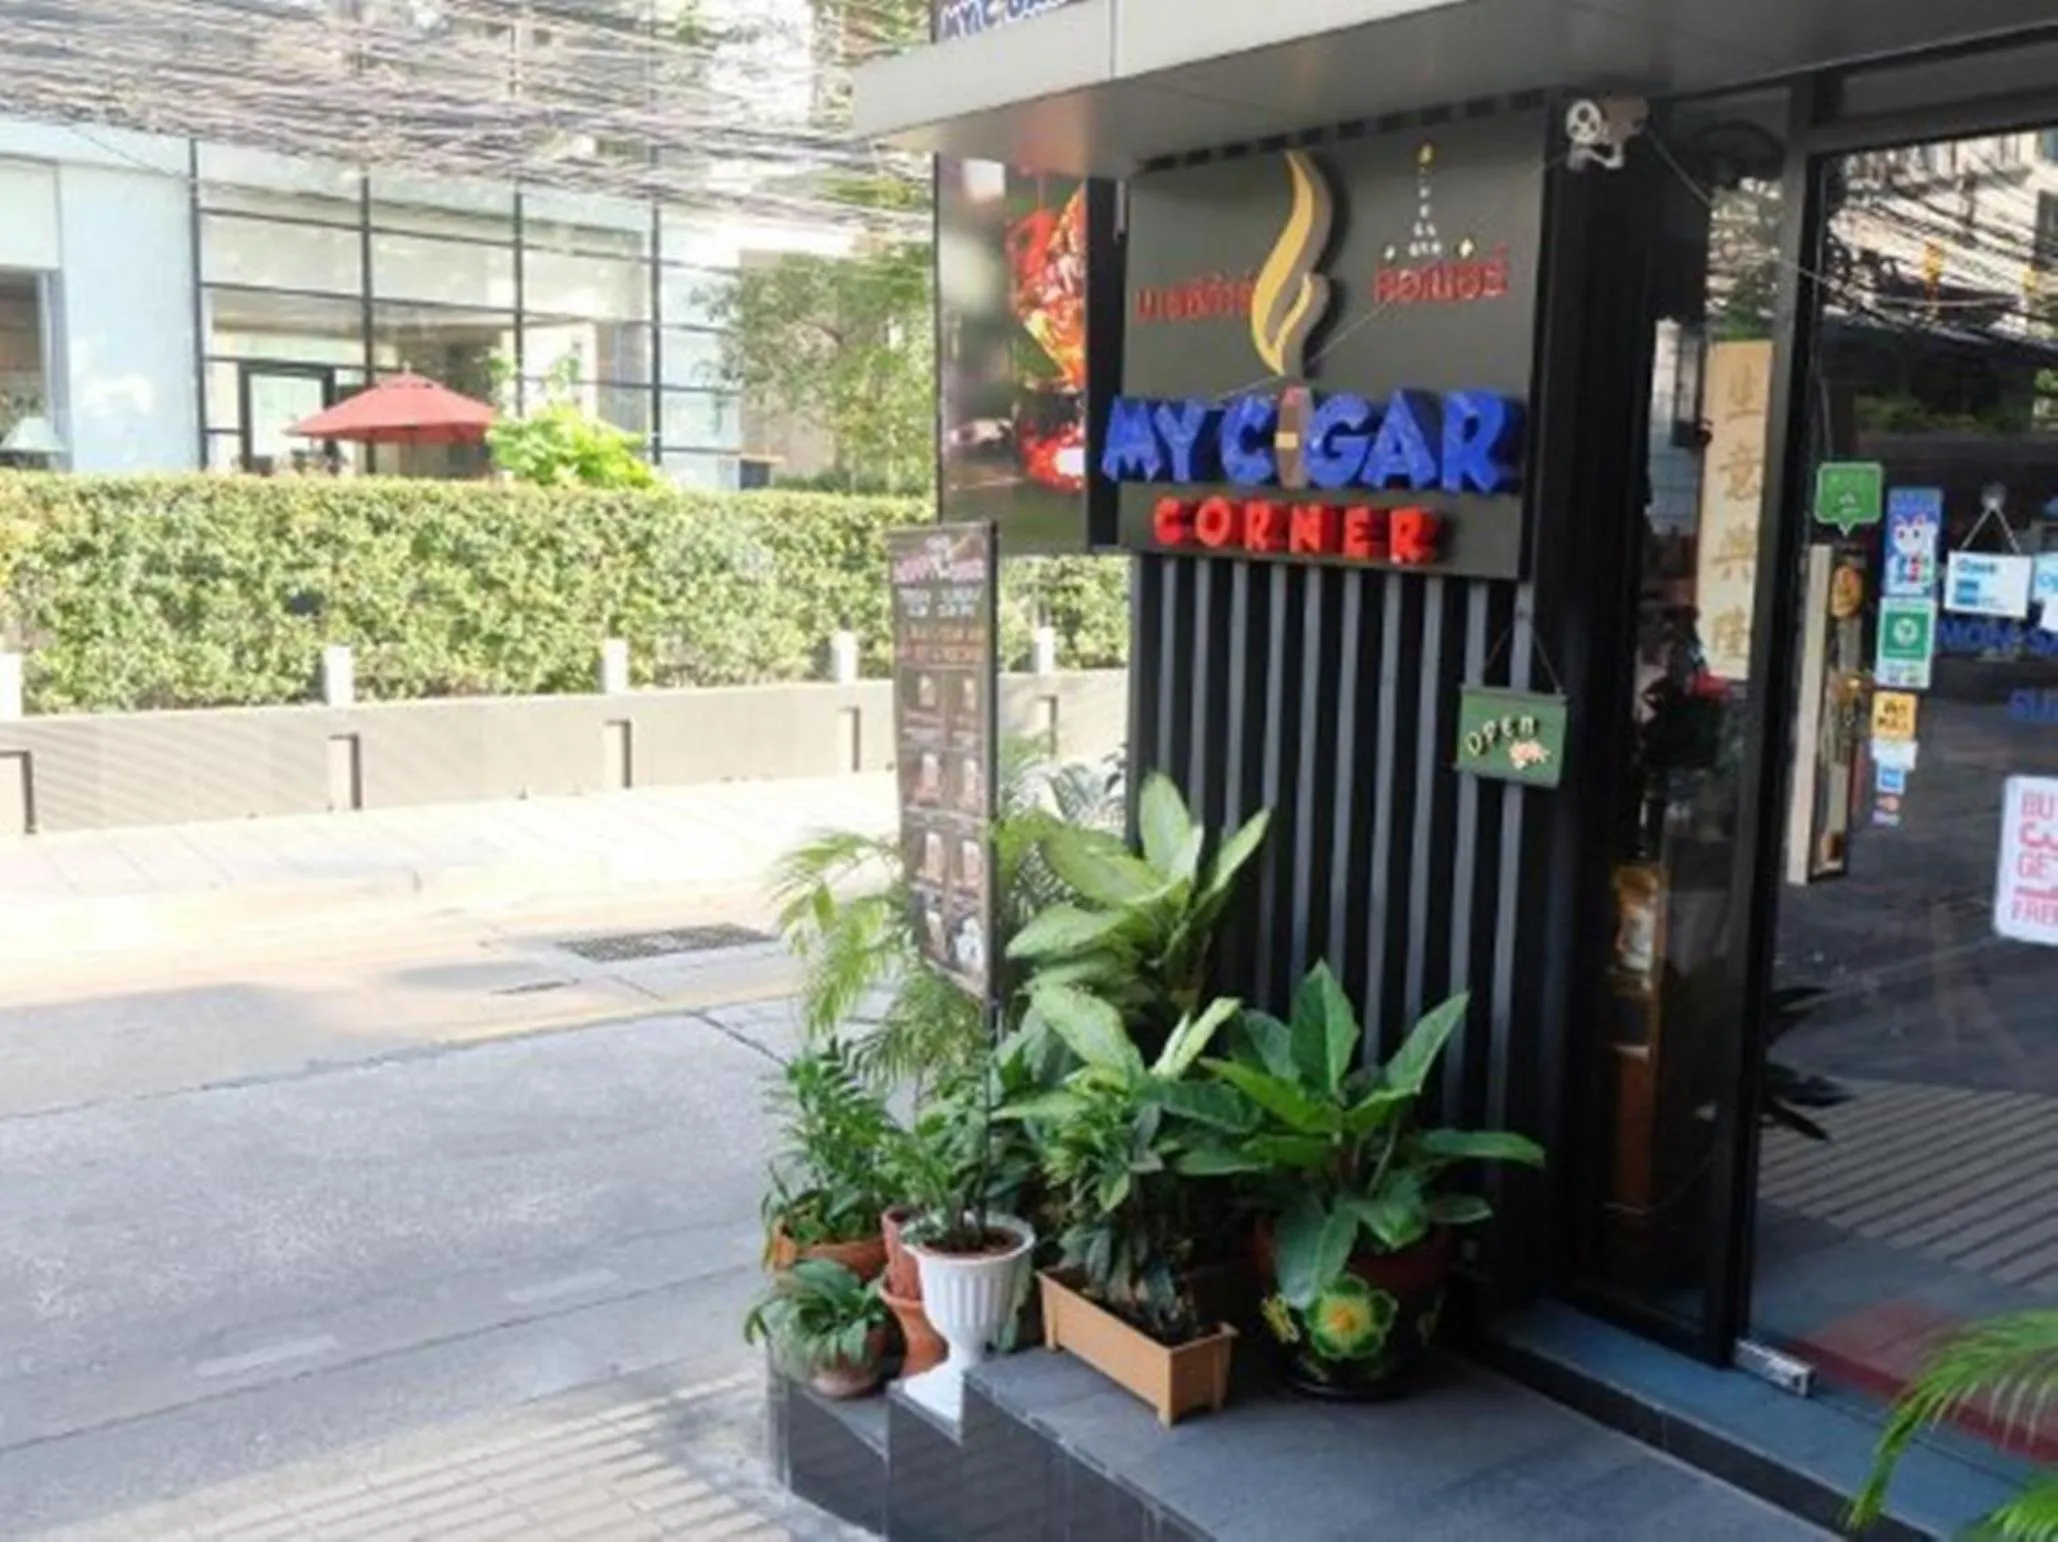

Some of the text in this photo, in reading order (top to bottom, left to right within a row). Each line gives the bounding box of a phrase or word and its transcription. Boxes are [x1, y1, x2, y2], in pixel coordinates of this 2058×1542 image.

[1102, 386, 1512, 494] MY CIGAR
[1153, 495, 1438, 566] CORNER
